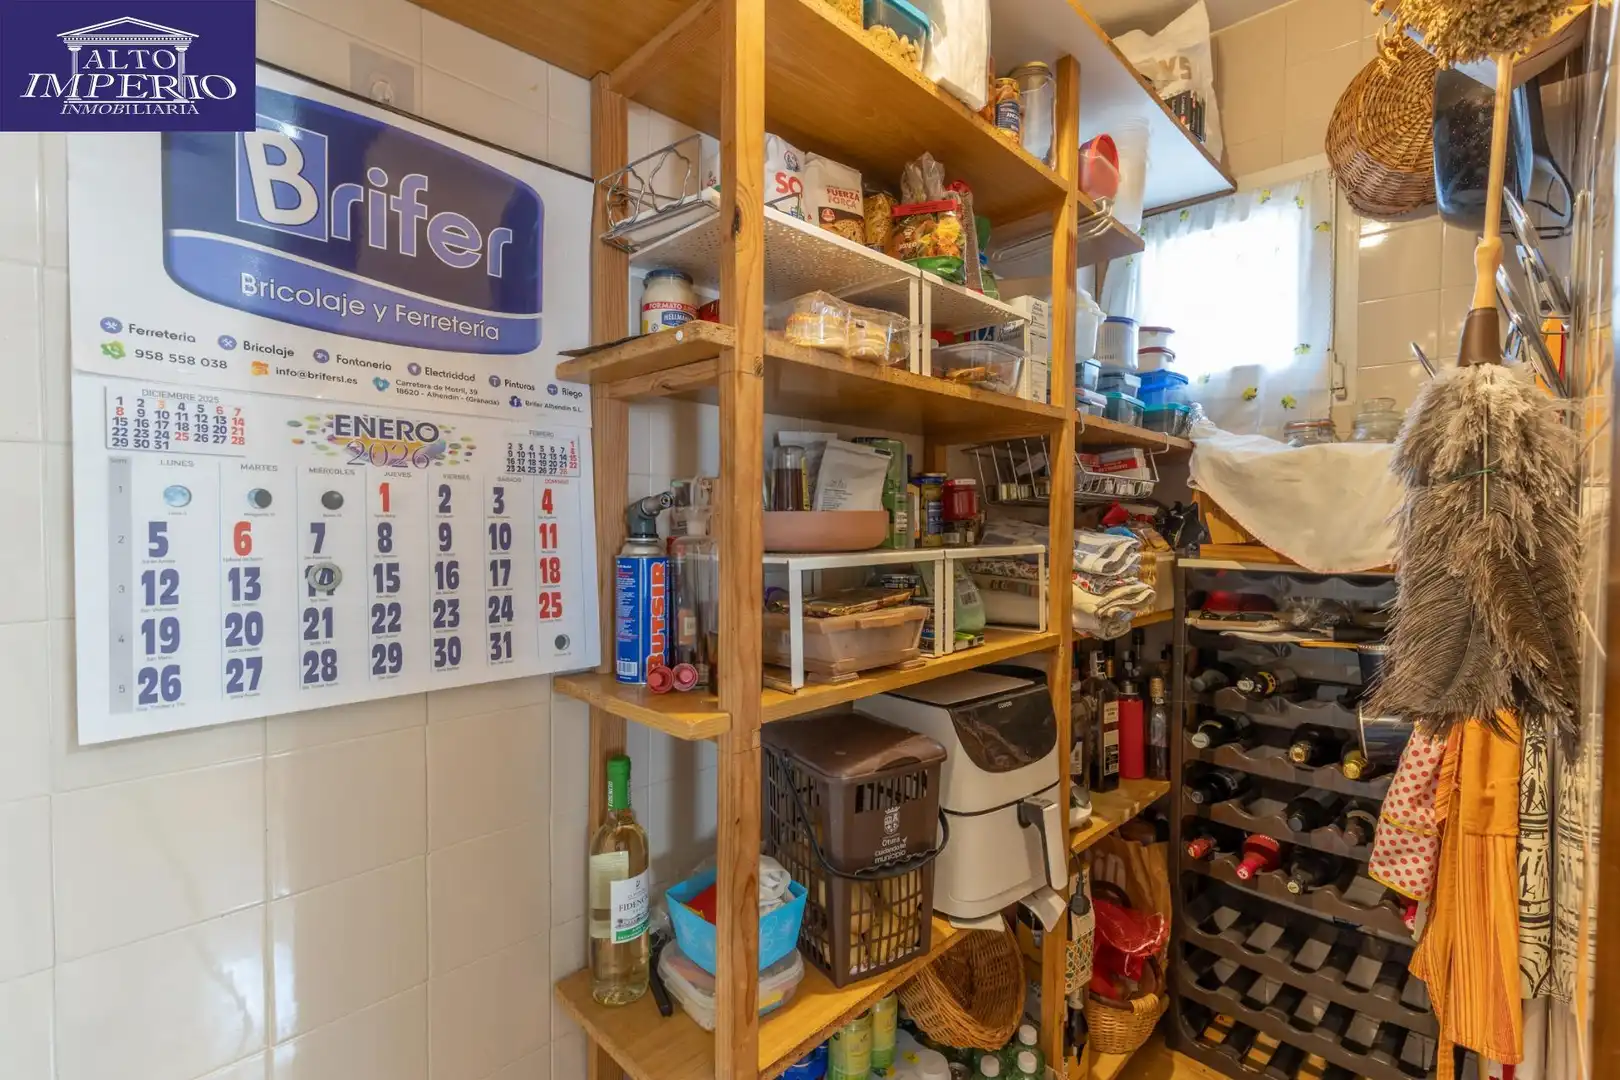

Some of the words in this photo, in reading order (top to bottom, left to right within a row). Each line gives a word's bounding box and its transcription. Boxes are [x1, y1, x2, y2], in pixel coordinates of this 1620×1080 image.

[243, 130, 513, 278] Brifer
[826, 188, 860, 202] FUERZA
[240, 272, 365, 318] Bricolaje
[372, 303, 387, 322] y
[396, 304, 500, 341] Ferretería
[128, 323, 196, 343] Ferreteria
[243, 341, 294, 358] Bricolaje
[336, 354, 392, 371] Fontaneria
[424, 367, 476, 382] Electricidad
[504, 378, 535, 392] Pinturas
[561, 387, 583, 399] Riego
[134, 349, 163, 361] 958
[169, 353, 196, 366] 558
[200, 358, 228, 370] 038
[275, 367, 358, 386] info@brifersl.es
[396, 379, 432, 391] Carretera
[142, 389, 196, 401] DICIEMBRE
[198, 394, 219, 404] 2025
[396, 388, 420, 396] 18620
[116, 396, 122, 405] 1
[137, 398, 144, 408] 2
[178, 402, 185, 411] 4
[198, 405, 204, 413] 5
[216, 406, 224, 414] 6
[234, 408, 241, 416] 7
[113, 417, 128, 426] 15
[134, 419, 149, 428] 16
[155, 421, 169, 429] 17
[175, 422, 189, 431] 18
[195, 424, 208, 432] 19
[213, 425, 227, 434] 20
[232, 427, 244, 436] 21
[116, 407, 124, 416] 8
[137, 409, 145, 417] 9
[155, 411, 169, 419] 10
[175, 413, 188, 421] 11
[195, 414, 208, 422] 12
[213, 416, 226, 424] 13
[232, 418, 244, 426] 14
[112, 427, 128, 436] 22
[134, 429, 149, 438] 23
[155, 430, 169, 439] 24
[175, 432, 189, 441] 25
[194, 434, 208, 442] 26
[213, 435, 226, 444] 27
[232, 436, 245, 445] 28
[334, 415, 440, 443] ENERO
[113, 438, 128, 447] 29
[134, 439, 149, 448] 30
[155, 441, 169, 449] 31
[347, 440, 430, 469] 2026
[160, 459, 195, 467] LUNES
[240, 464, 278, 472] MARTES
[384, 471, 412, 479] JUEVES
[379, 483, 389, 512] 1
[438, 484, 451, 513] 2
[493, 487, 504, 514] 3
[541, 489, 553, 514] 4
[118, 536, 125, 544] 2
[148, 522, 169, 558] 5
[234, 521, 252, 556] 6
[310, 523, 325, 553] 7
[378, 522, 392, 553] 8
[438, 522, 452, 551] 9
[489, 523, 511, 550] 10
[539, 523, 557, 549] 11
[118, 585, 125, 593] 3
[141, 568, 180, 606] 12
[228, 567, 262, 601] 13
[373, 562, 400, 593] 15
[435, 560, 459, 590] 16
[490, 559, 511, 586] 17
[539, 557, 561, 584] 18
[118, 635, 125, 644] 4
[141, 616, 180, 655] 19
[225, 611, 263, 647] 20
[304, 607, 333, 640] 21
[371, 602, 401, 634] 22
[433, 599, 459, 628] 23
[488, 595, 513, 623] 24
[539, 592, 562, 619] 25
[646, 561, 666, 676] BUTSIR
[119, 685, 126, 693] 5
[138, 665, 181, 705] 26
[226, 657, 262, 694] 27
[304, 649, 337, 684] 28
[372, 642, 402, 675] 29
[434, 636, 461, 667] 30
[490, 632, 512, 661] 31
[874, 850, 906, 864] municipio
